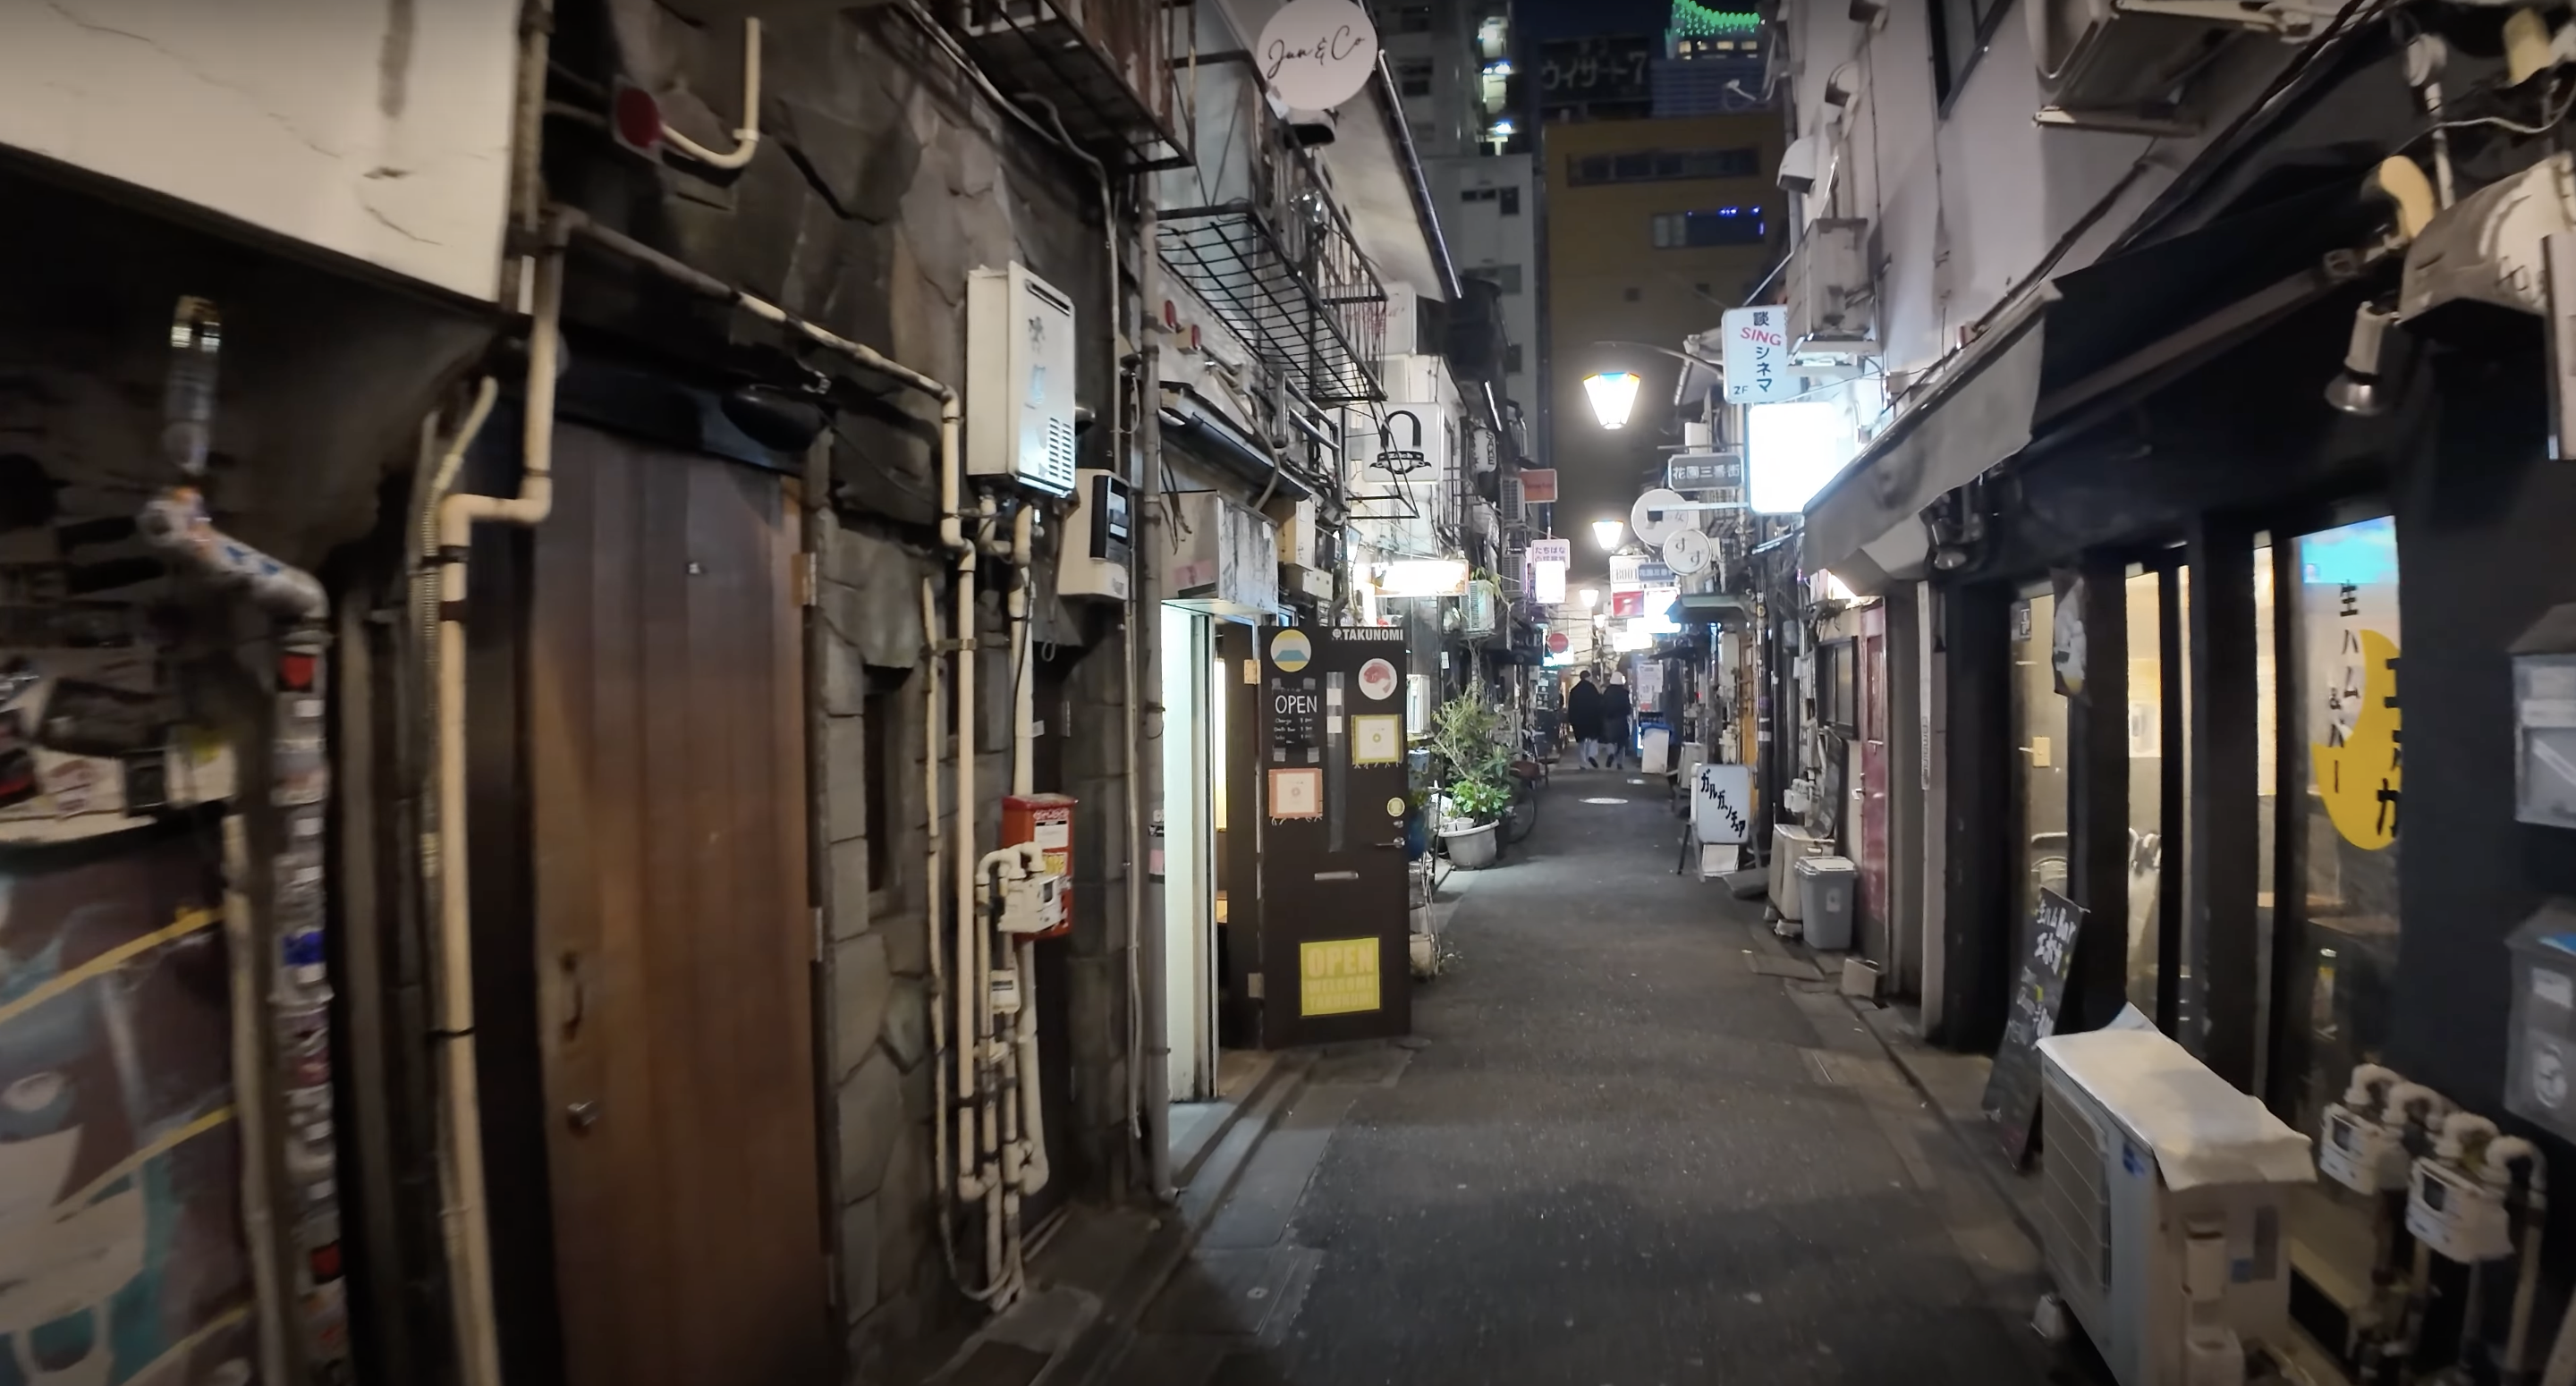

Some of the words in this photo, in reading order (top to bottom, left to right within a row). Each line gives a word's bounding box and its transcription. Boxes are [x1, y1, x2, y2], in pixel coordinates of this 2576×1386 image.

[1331, 25, 1366, 61] Co
[1740, 326, 1782, 346] SING
[1756, 346, 1773, 393] シネマ
[1486, 431, 1495, 465] SAKE
[1673, 464, 1741, 480] 花園三番街
[1343, 629, 1403, 641] TAKUNOMI
[1275, 695, 1318, 714] OPEN
[1307, 943, 1374, 976] OPEN
